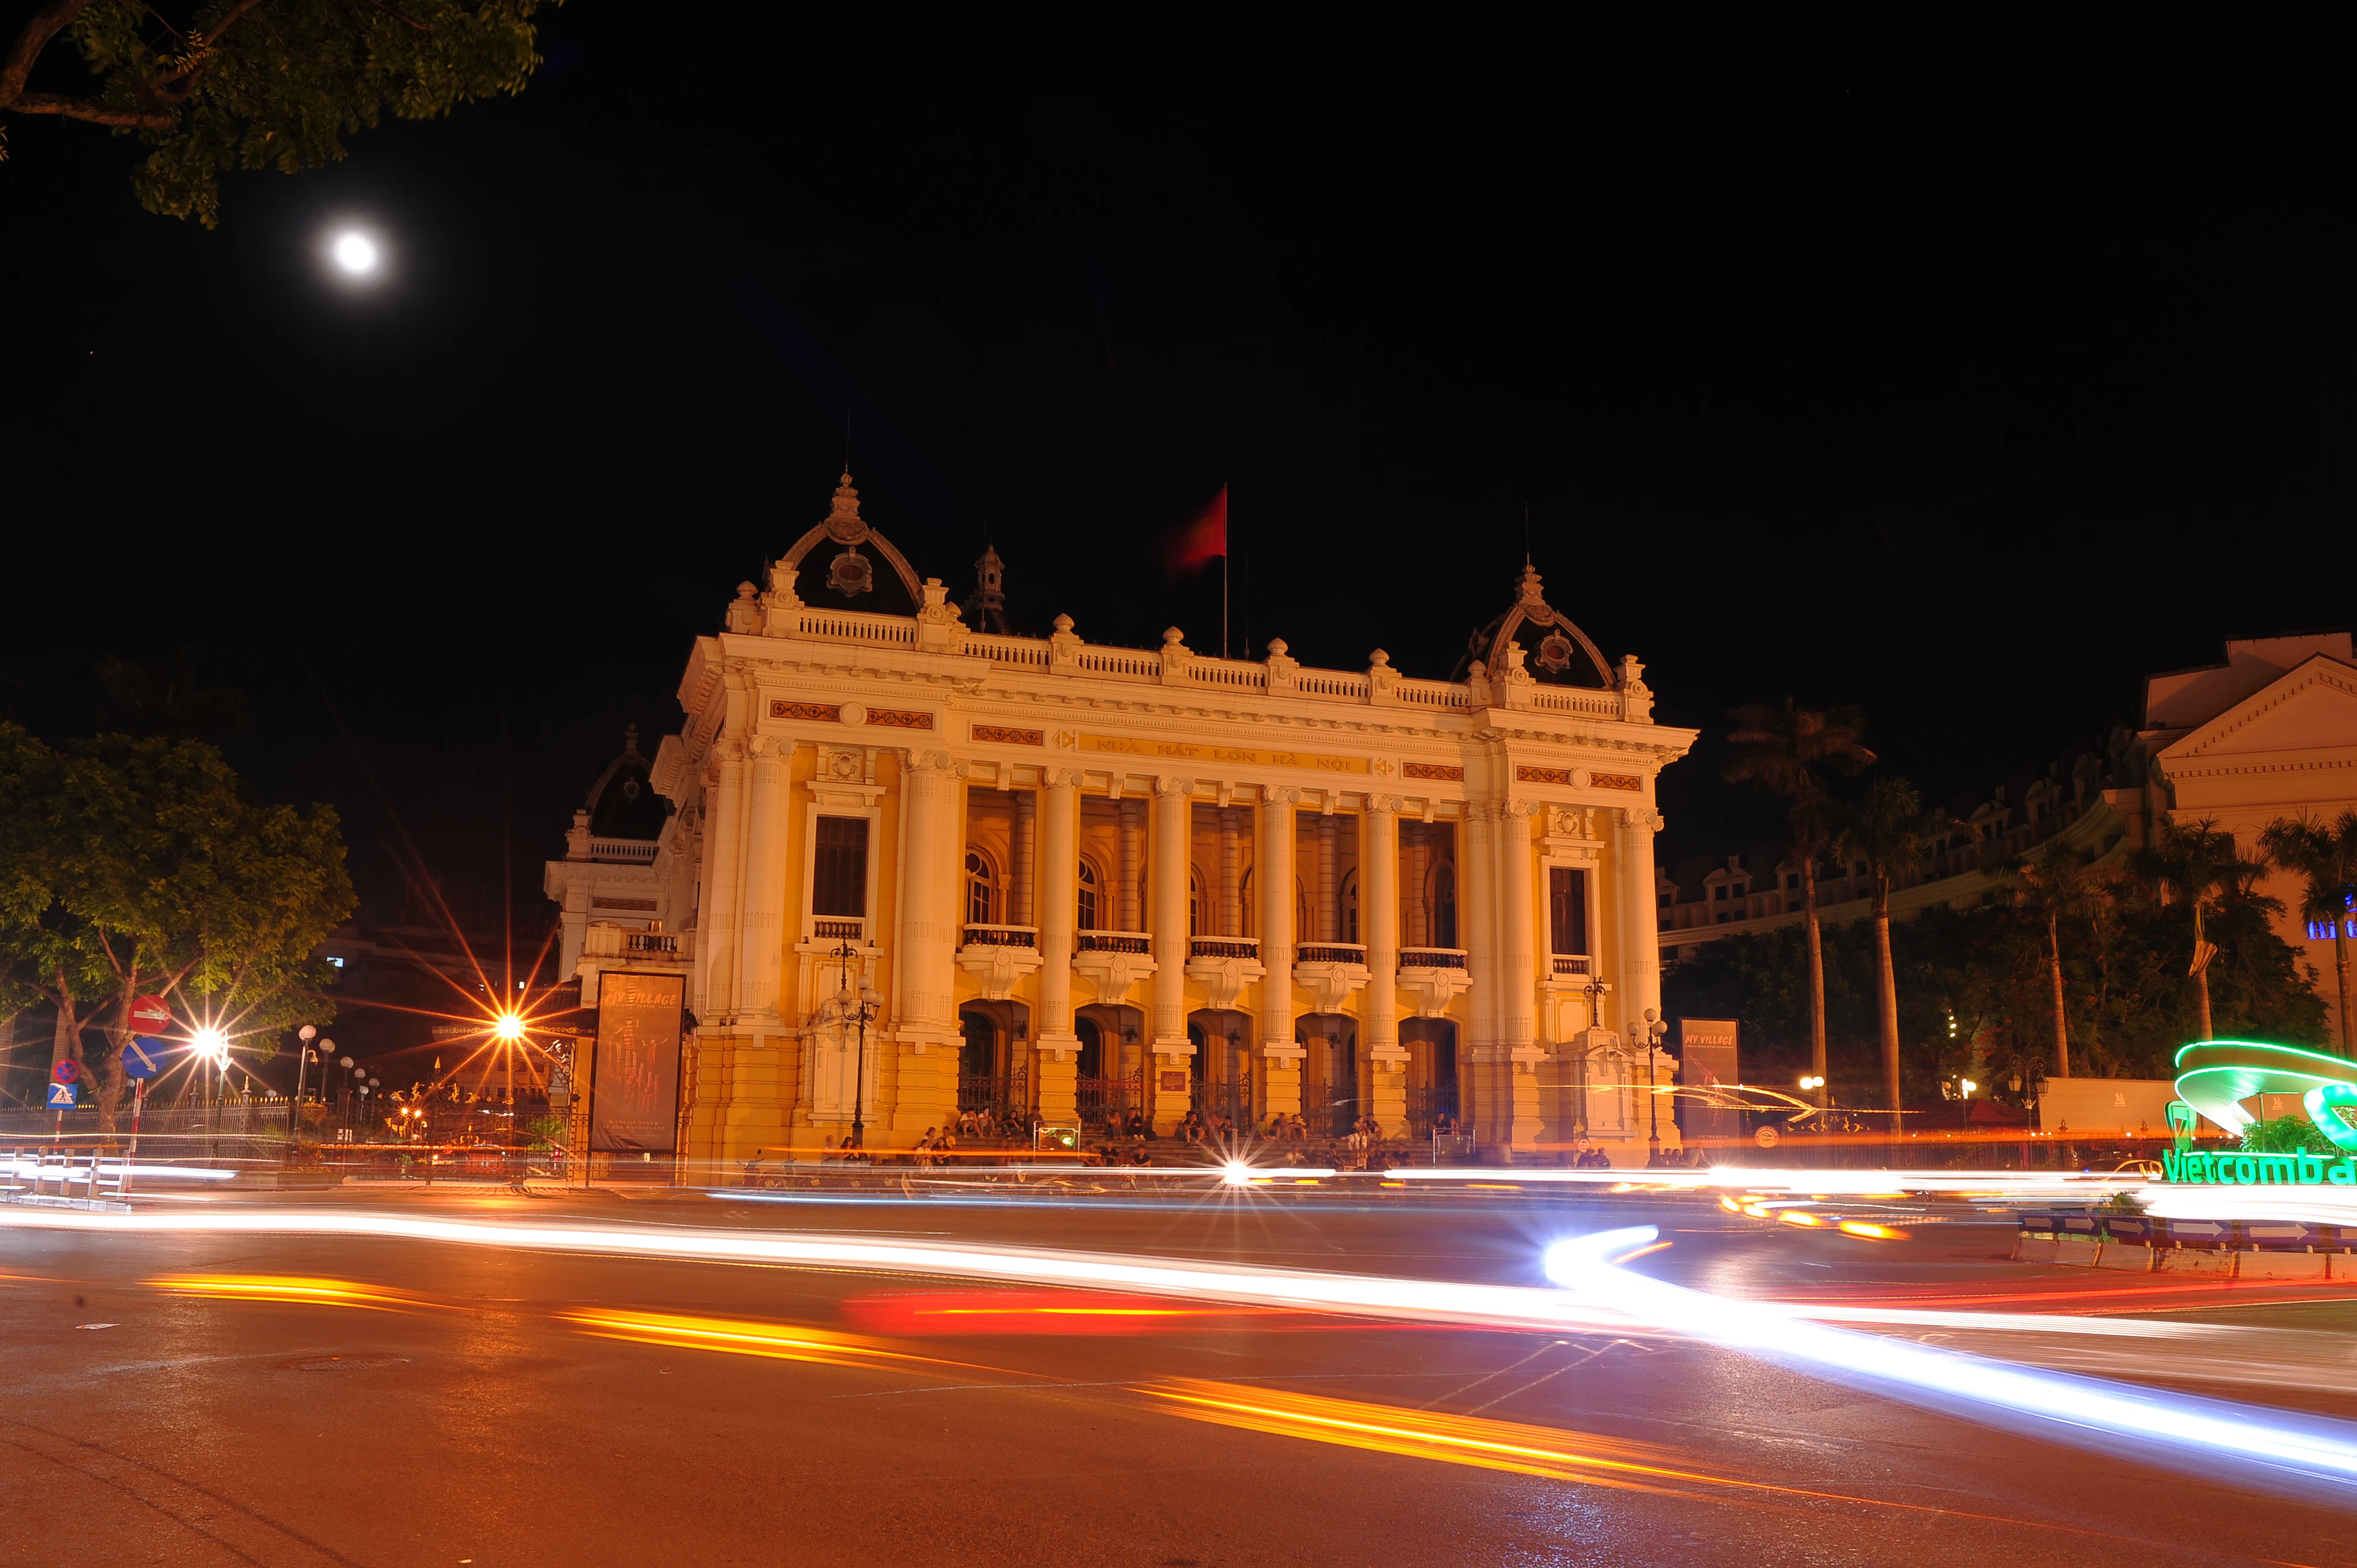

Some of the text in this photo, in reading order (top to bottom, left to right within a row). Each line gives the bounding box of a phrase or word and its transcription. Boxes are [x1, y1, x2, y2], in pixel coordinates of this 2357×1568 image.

[1685, 1034, 1733, 1045] MY VILLAGE
[2163, 1146, 2356, 1185] Vietcomba
